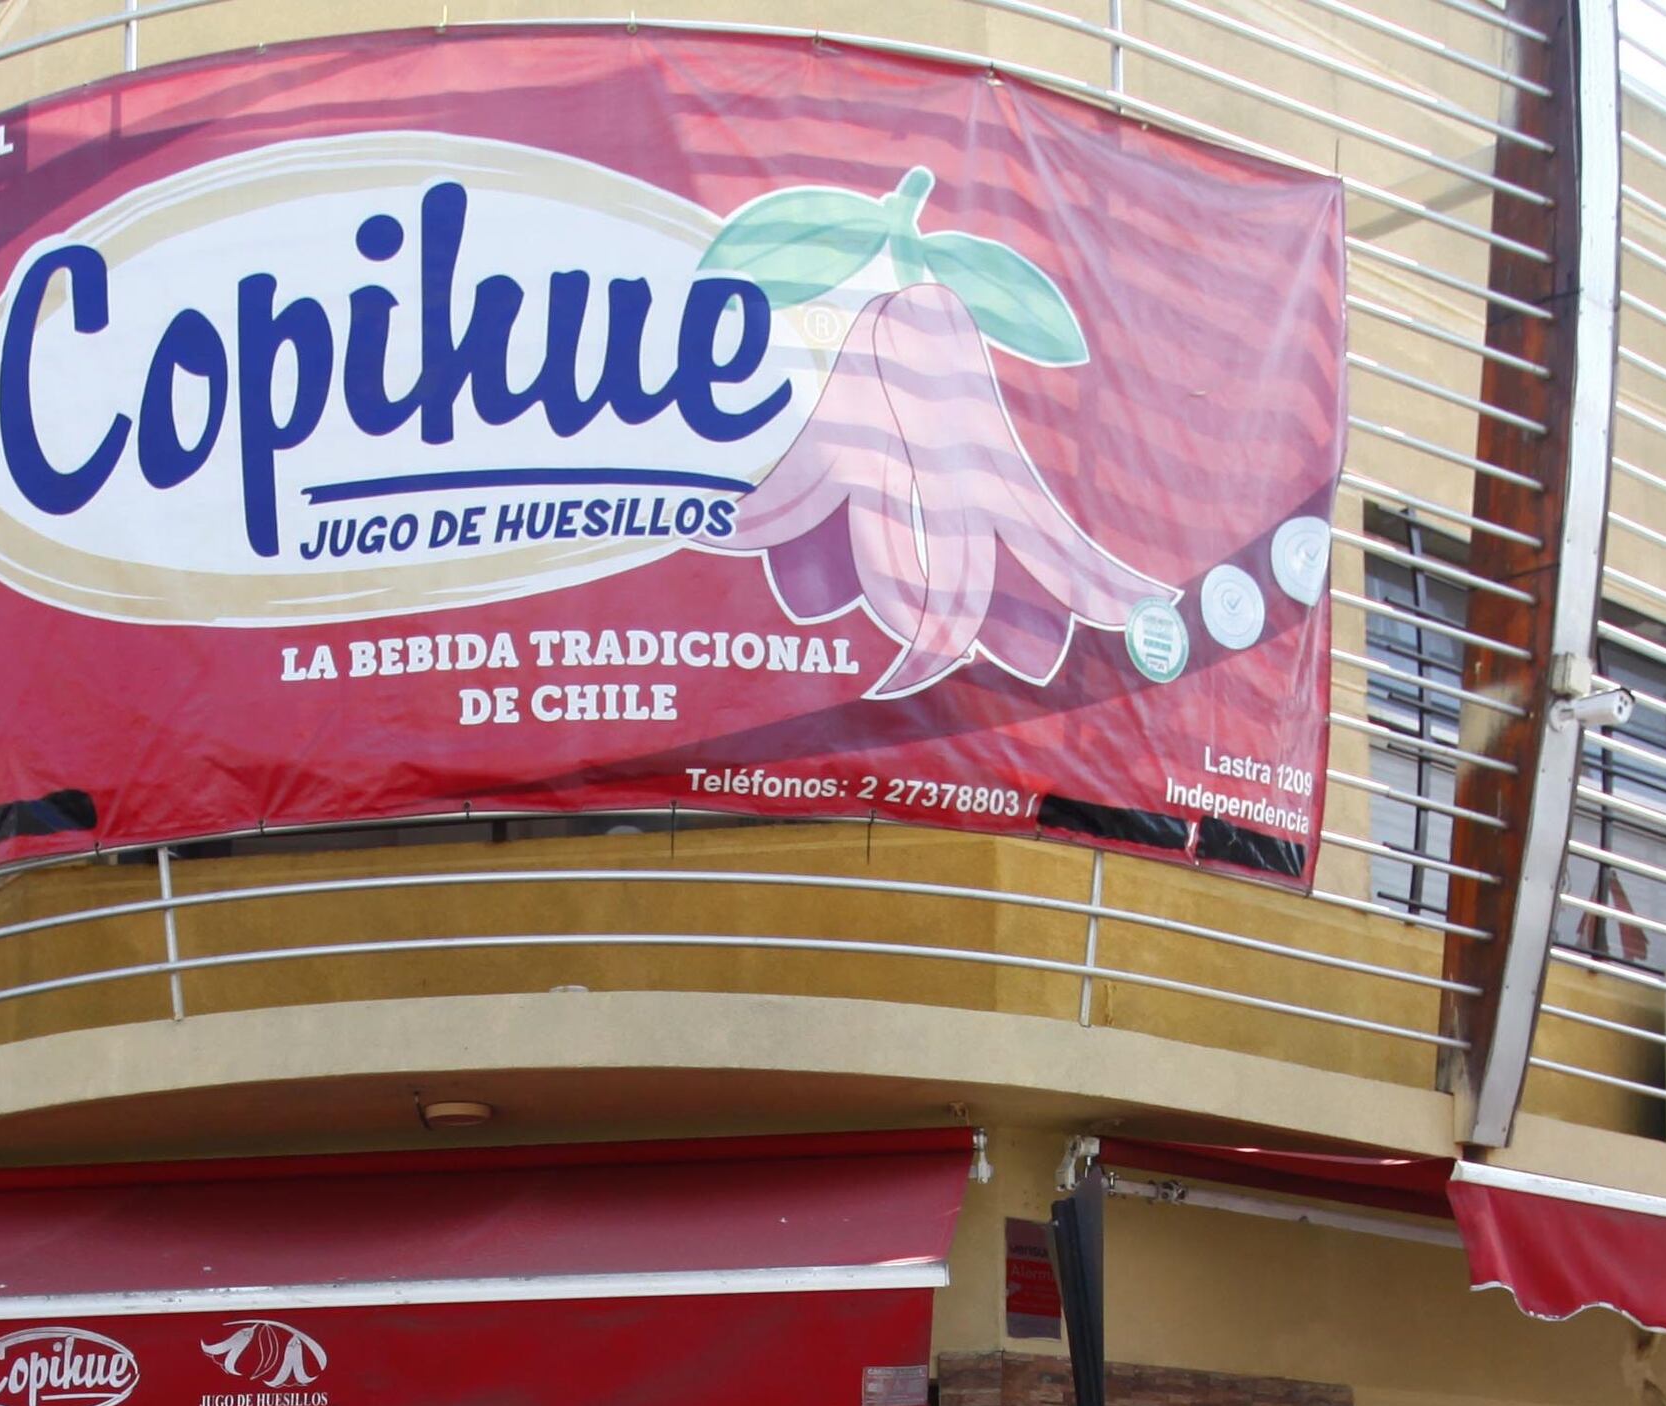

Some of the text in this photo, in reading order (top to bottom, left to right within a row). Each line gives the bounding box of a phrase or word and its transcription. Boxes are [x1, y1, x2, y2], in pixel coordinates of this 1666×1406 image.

[299, 519, 418, 561] JUGO
[429, 511, 480, 548] DE
[281, 629, 860, 681] LA BEBIDA TRADICIONAL
[459, 684, 679, 726] DE CHILE
[685, 767, 849, 800] Teléfonos:
[857, 775, 877, 801] 2
[884, 780, 1020, 818] 27378803
[1203, 745, 1314, 799] Lastra 1209
[1165, 776, 1311, 838] Independencia
